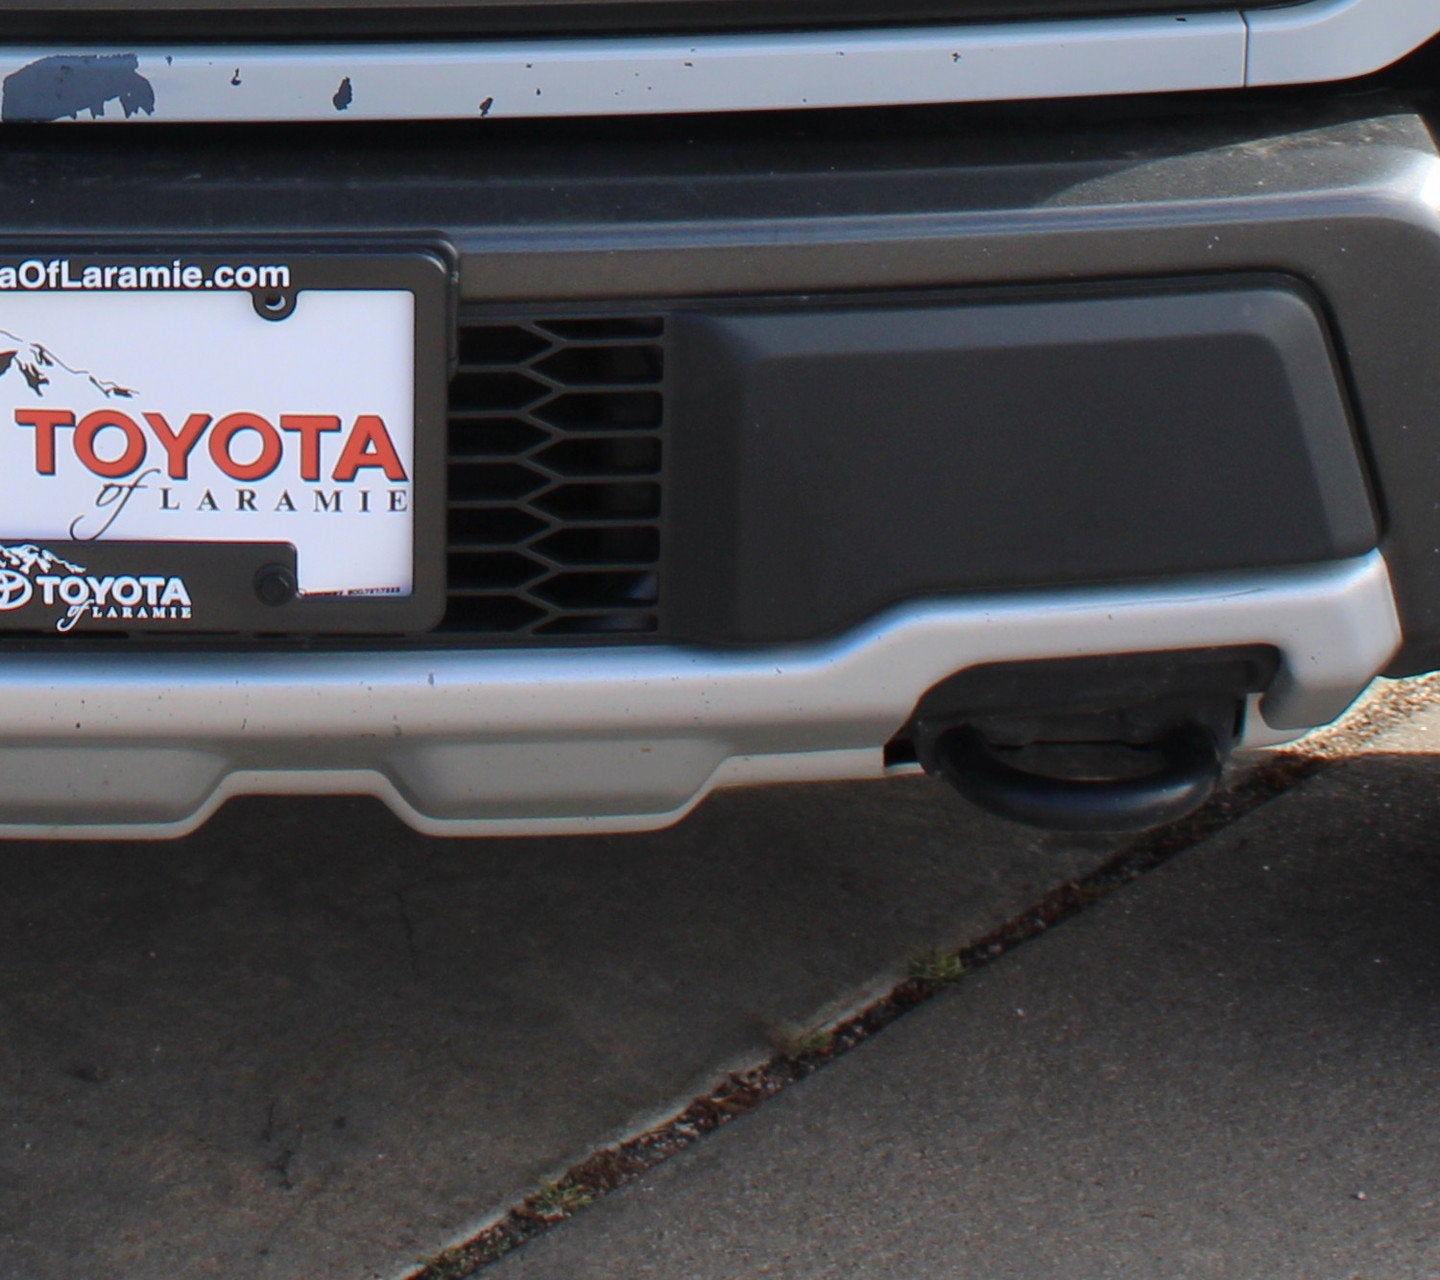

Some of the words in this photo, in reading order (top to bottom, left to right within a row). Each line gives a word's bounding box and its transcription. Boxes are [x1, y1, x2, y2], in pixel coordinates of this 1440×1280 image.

[14, 409, 409, 482] TOYOTA
[69, 468, 161, 542] of
[159, 488, 409, 513] LARAMIE
[35, 575, 192, 606] TOYOTA
[56, 599, 94, 632] of
[91, 606, 193, 619] LARAMIE
